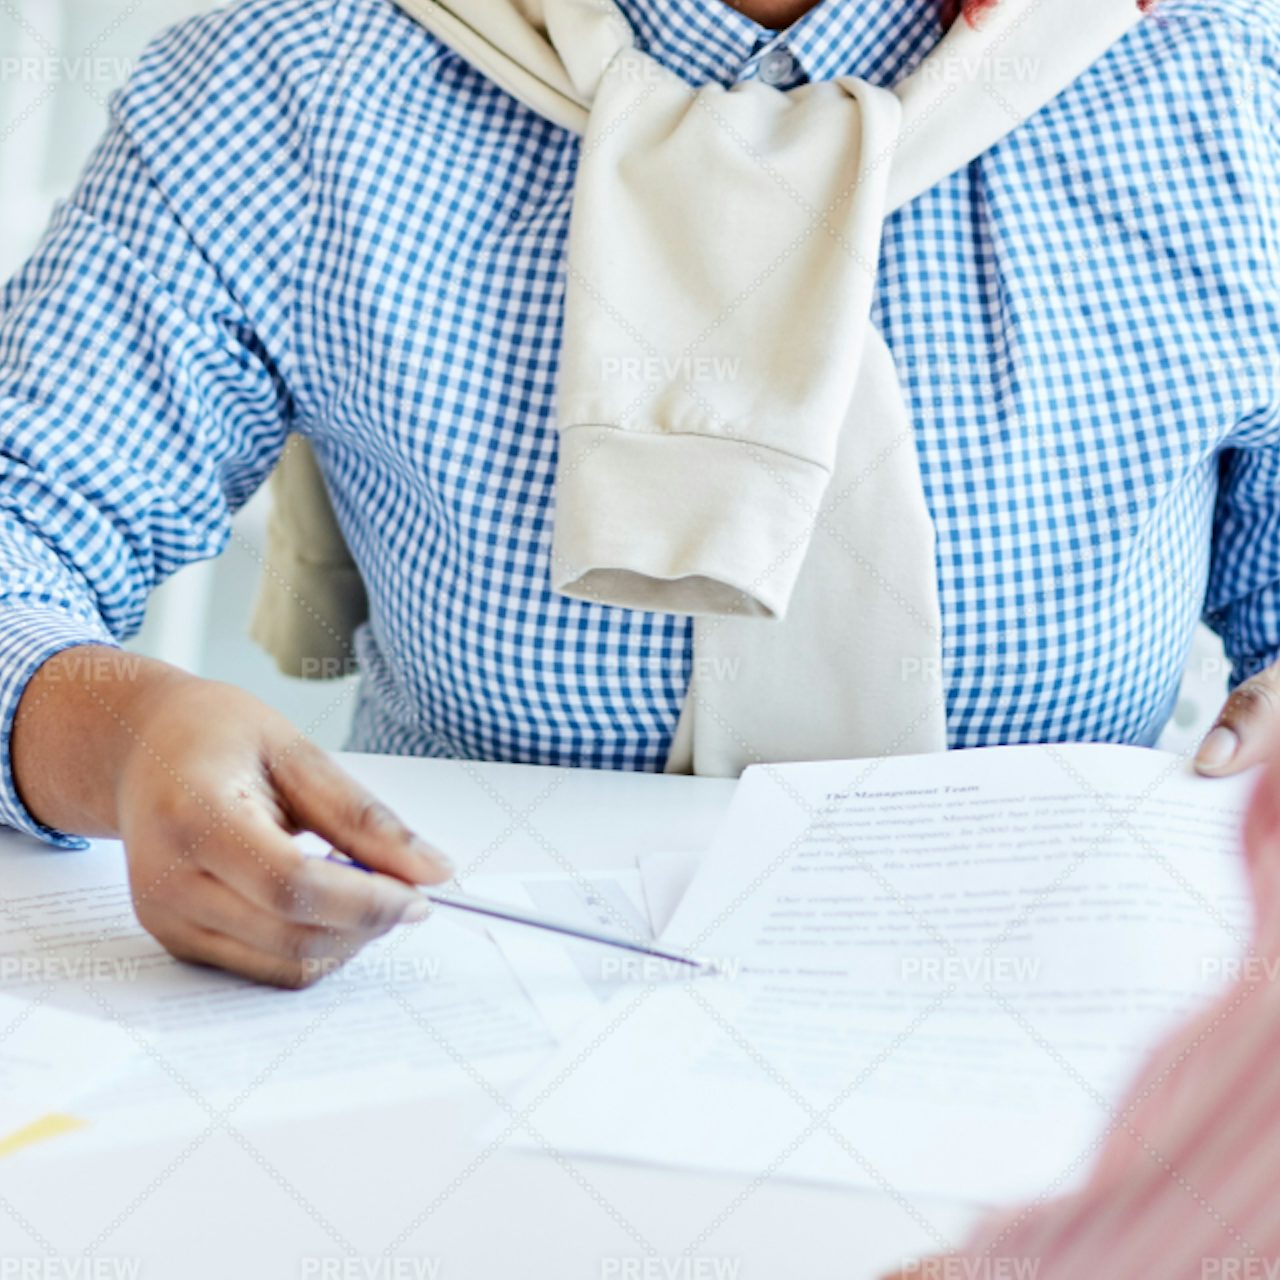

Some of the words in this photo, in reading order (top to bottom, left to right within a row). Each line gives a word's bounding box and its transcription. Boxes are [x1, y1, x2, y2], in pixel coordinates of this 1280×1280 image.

[825, 792, 849, 801] The
[854, 787, 938, 799] Management
[944, 784, 980, 794] Team
